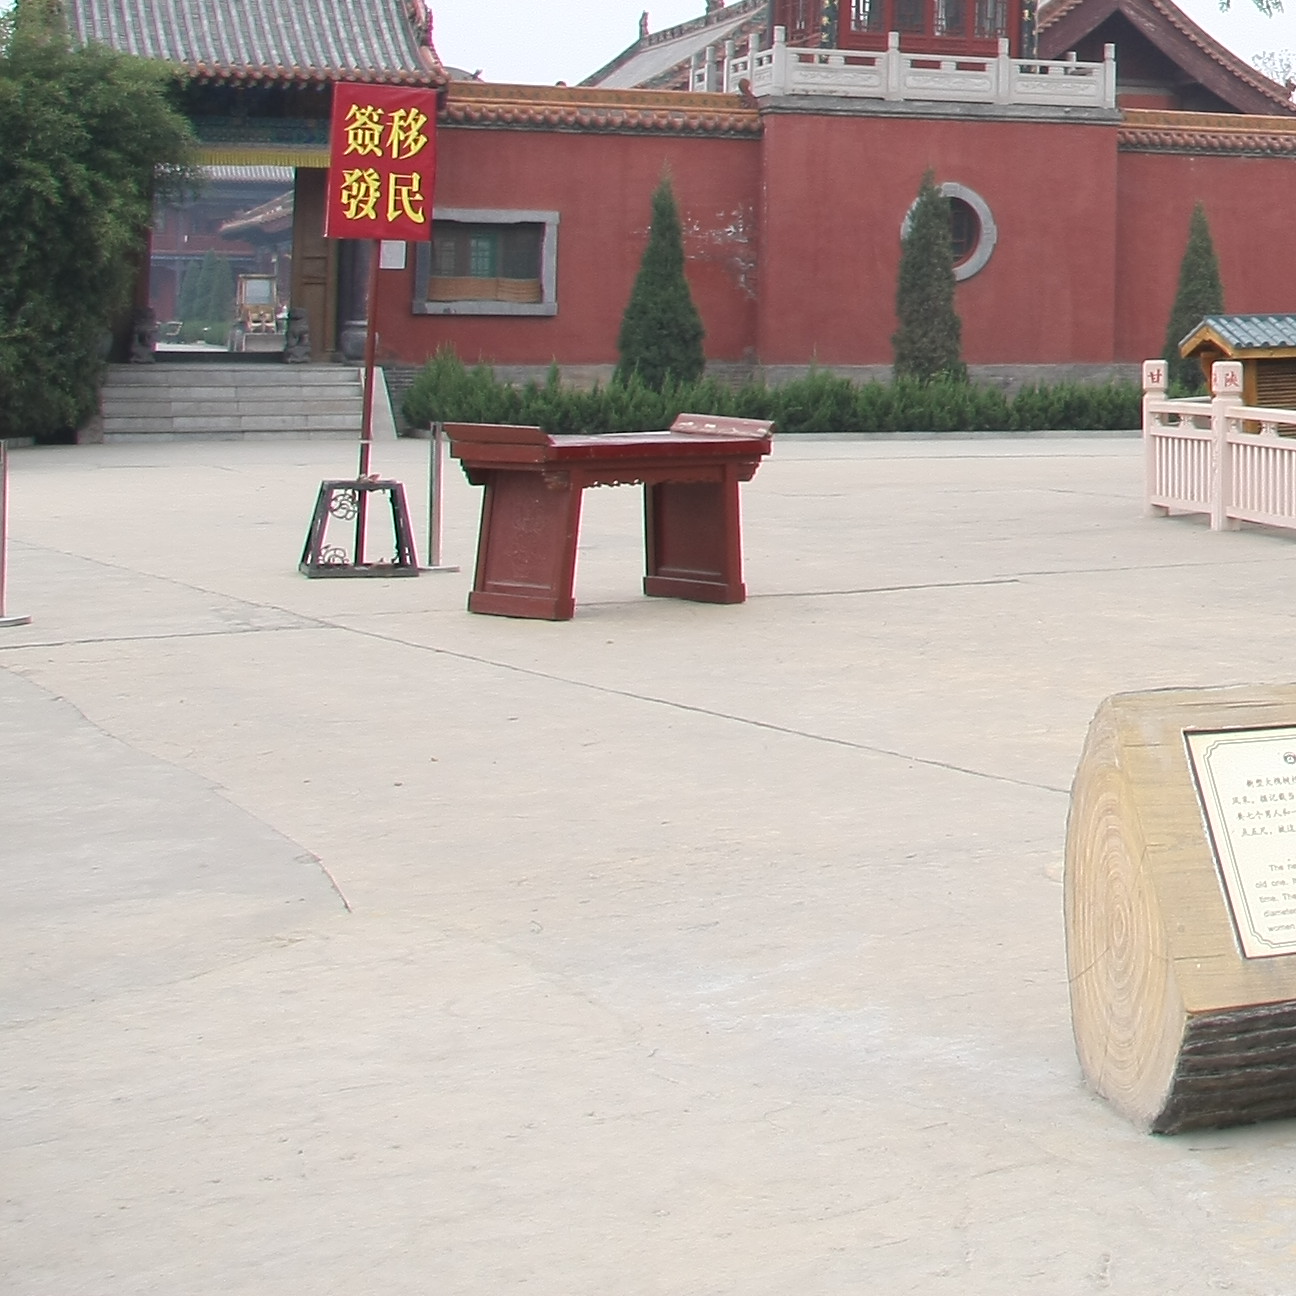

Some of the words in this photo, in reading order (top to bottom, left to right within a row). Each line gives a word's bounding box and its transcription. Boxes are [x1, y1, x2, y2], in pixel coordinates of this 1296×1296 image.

[340, 103, 386, 221] 簽發
[386, 107, 429, 224] 移民
[1147, 368, 1163, 384] 甘
